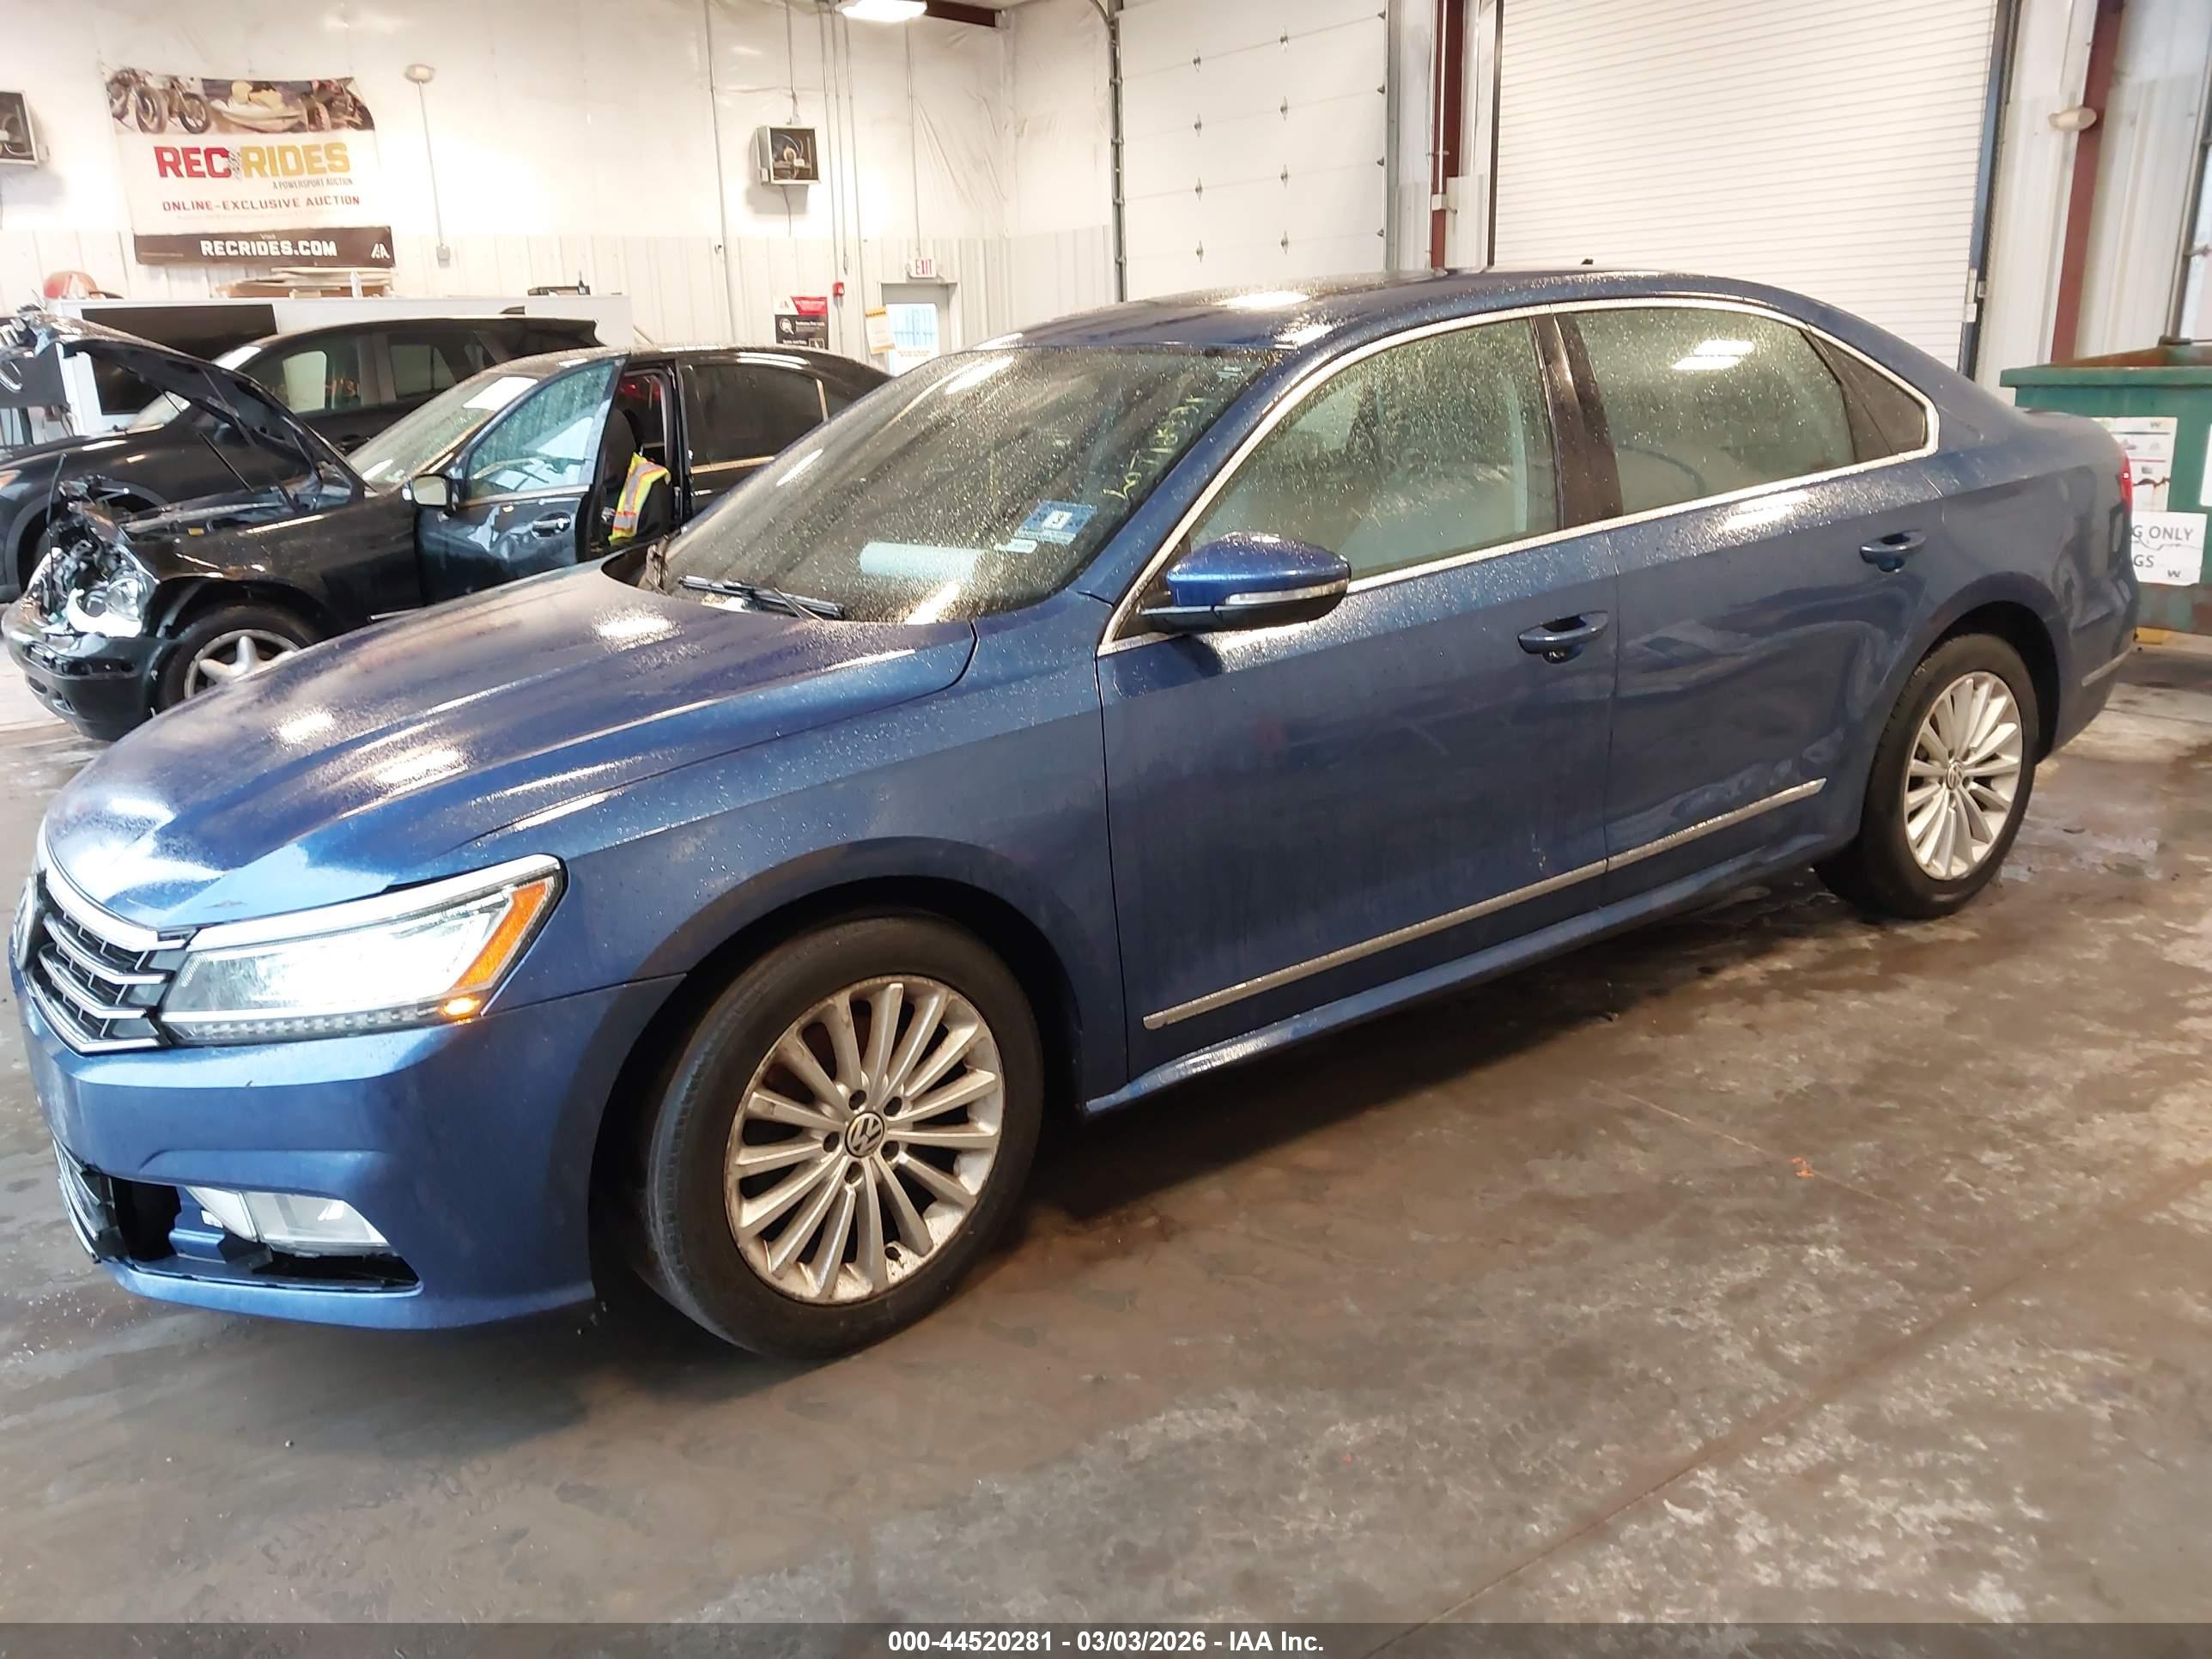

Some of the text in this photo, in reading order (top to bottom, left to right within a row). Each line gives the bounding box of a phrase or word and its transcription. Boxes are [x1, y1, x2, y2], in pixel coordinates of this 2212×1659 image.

[154, 143, 350, 179] REC RIDES
[279, 178, 325, 189] POWERSPORT
[326, 177, 354, 185] AUCTION
[162, 195, 360, 211] ONLINE-EXCLUSIVE AUCTION
[200, 240, 337, 257] RECRIDES.COM
[915, 259, 933, 276] EXIT
[2148, 526, 2194, 542] ONLY
